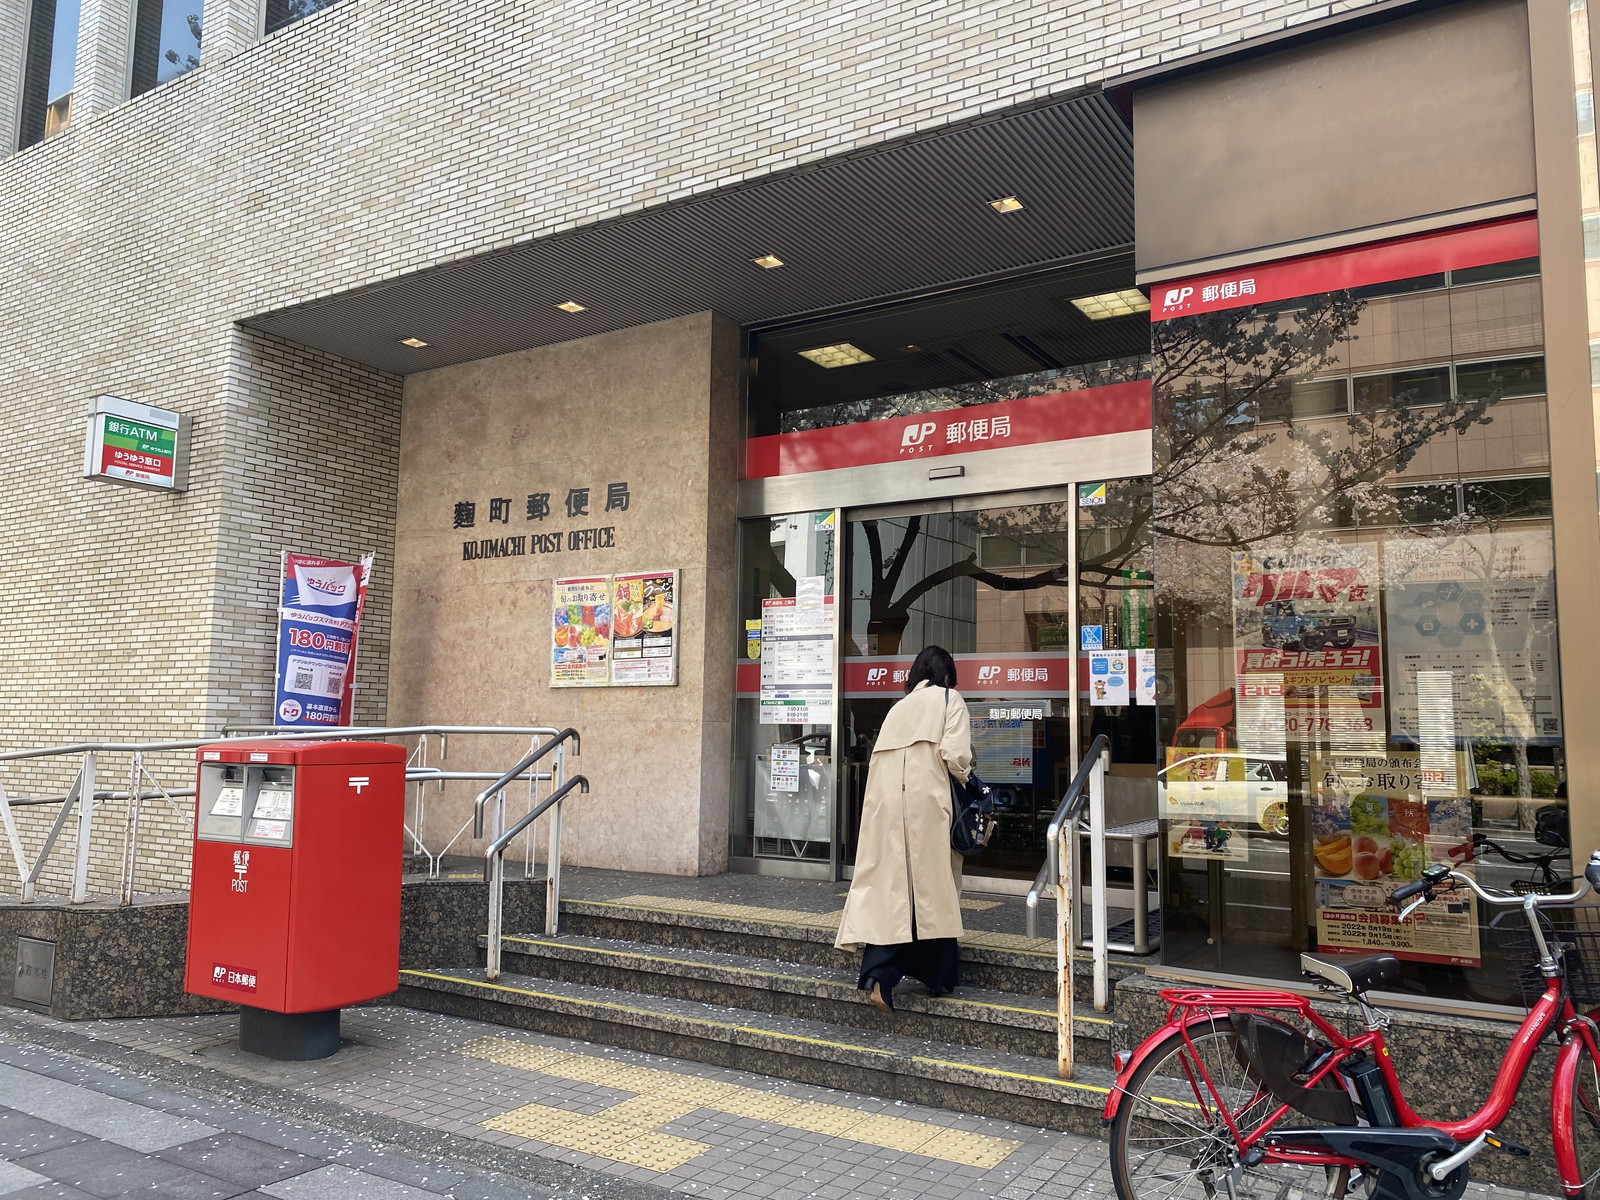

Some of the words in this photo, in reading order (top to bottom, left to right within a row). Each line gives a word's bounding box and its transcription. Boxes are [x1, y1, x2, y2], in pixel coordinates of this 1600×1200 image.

[1164, 287, 1194, 306] JP
[1202, 278, 1256, 302] 郵便局
[1162, 303, 1191, 312] POST
[108, 421, 157, 442] 銀行ATM
[902, 422, 936, 446] JP
[946, 416, 1011, 444] 郵便局
[900, 445, 933, 454] POST
[114, 451, 161, 467] ゆうゆう窓口
[1082, 497, 1103, 506] SENON
[462, 536, 526, 560] KOJIMACHI
[530, 532, 563, 554] POST
[568, 527, 615, 551] OFFICE
[307, 577, 346, 593] ゆうパック
[644, 580, 671, 598] ラーメン
[1246, 650, 1370, 668] 買おう!売ろう!
[867, 668, 888, 681] JP
[978, 666, 1001, 680] JP
[1007, 668, 1048, 682] 郵便局
[284, 708, 298, 716] トク
[1365, 802, 1374, 813] 夏
[1405, 808, 1414, 817] 秋
[233, 850, 250, 866] 郵便
[232, 879, 248, 892] POST
[1358, 914, 1412, 926] 会員募集中
[214, 966, 226, 978] JP
[228, 971, 256, 988] 日本郵便
